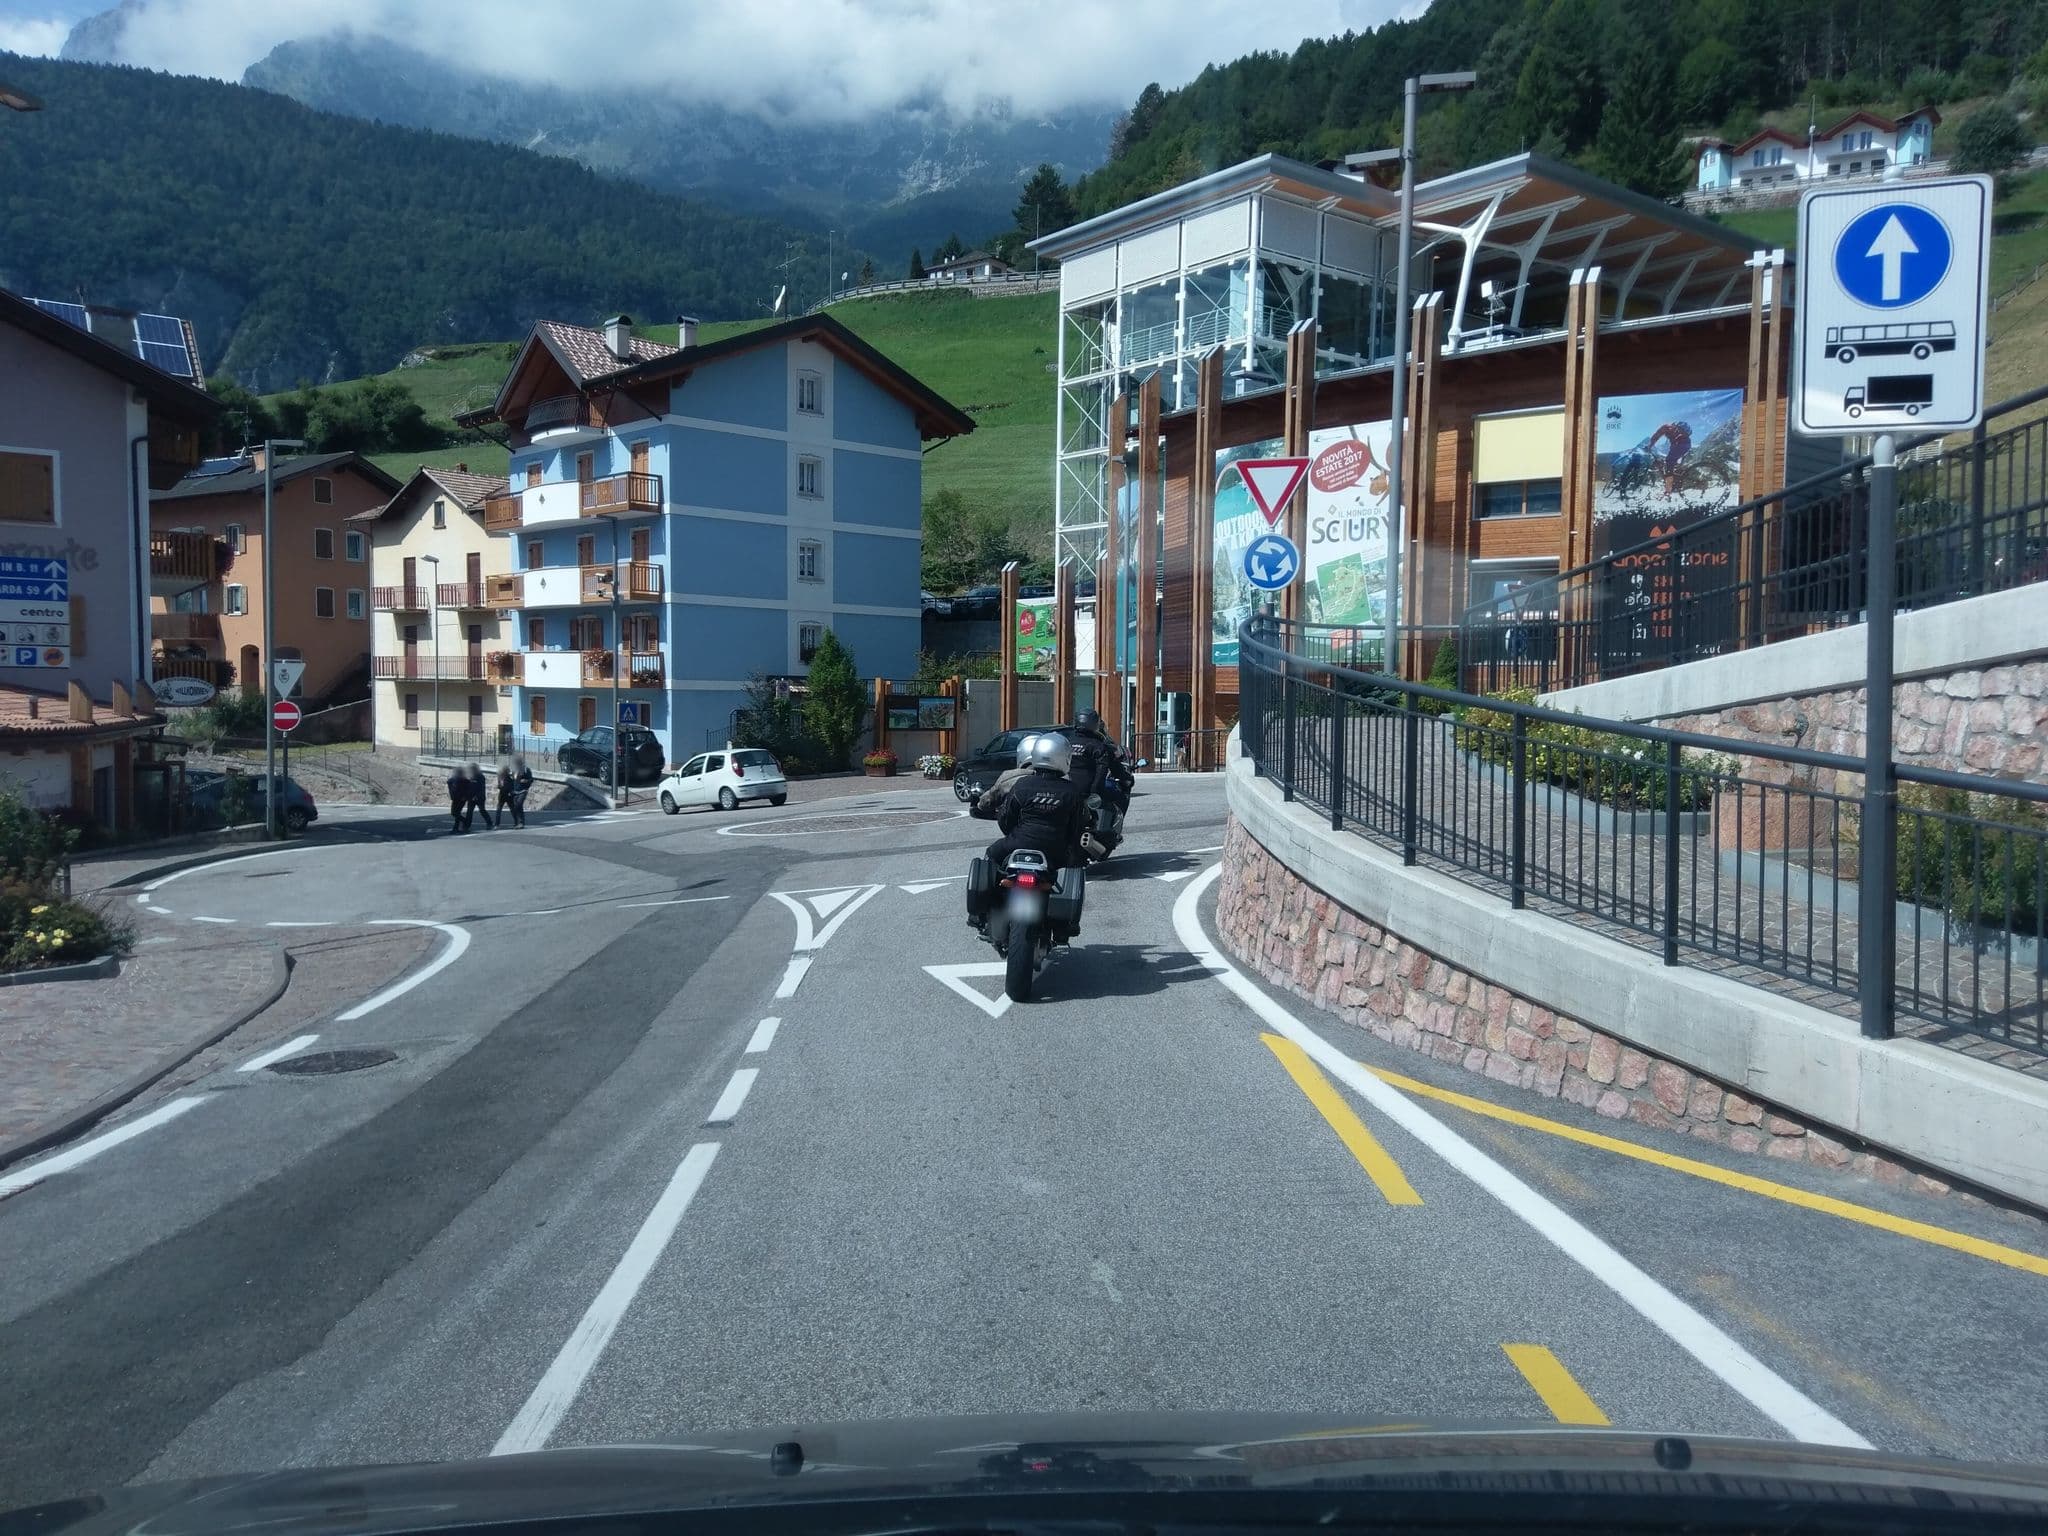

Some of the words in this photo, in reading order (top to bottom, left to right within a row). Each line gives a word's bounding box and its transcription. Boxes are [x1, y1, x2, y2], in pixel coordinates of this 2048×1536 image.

[1321, 444, 1354, 466] NOVITÀ
[1315, 461, 1344, 478] ESTATE
[1343, 450, 1364, 466] 2017
[26, 585, 40, 596] 59
[20, 607, 65, 618] centro
